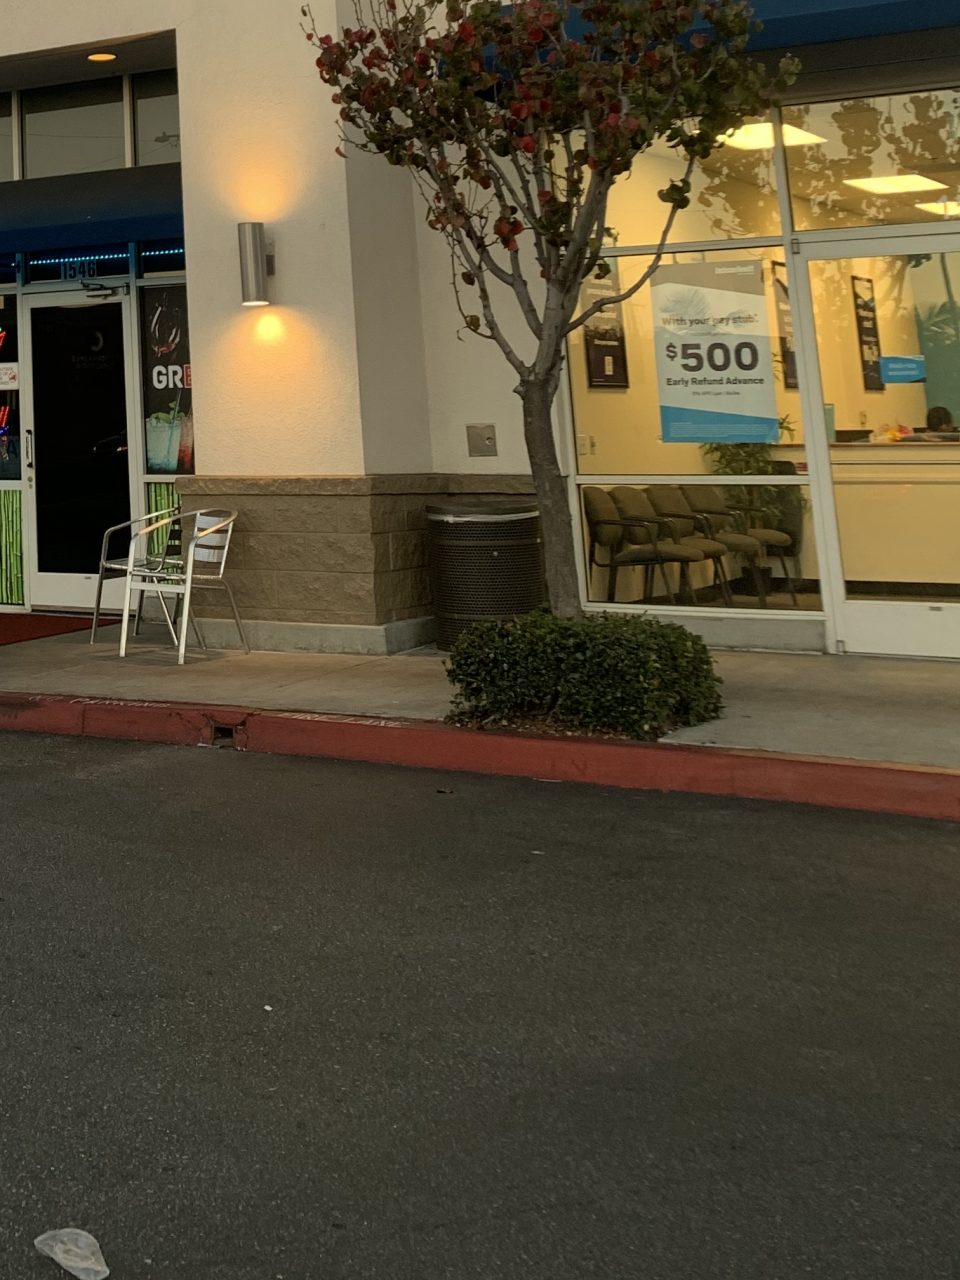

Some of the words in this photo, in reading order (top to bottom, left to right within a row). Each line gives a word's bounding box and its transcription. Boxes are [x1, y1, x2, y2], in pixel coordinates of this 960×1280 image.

[62, 261, 96, 279] 1546
[665, 341, 759, 373] $500
[666, 377, 689, 388] Early
[690, 376, 724, 386] Refund
[726, 375, 765, 386] Advance
